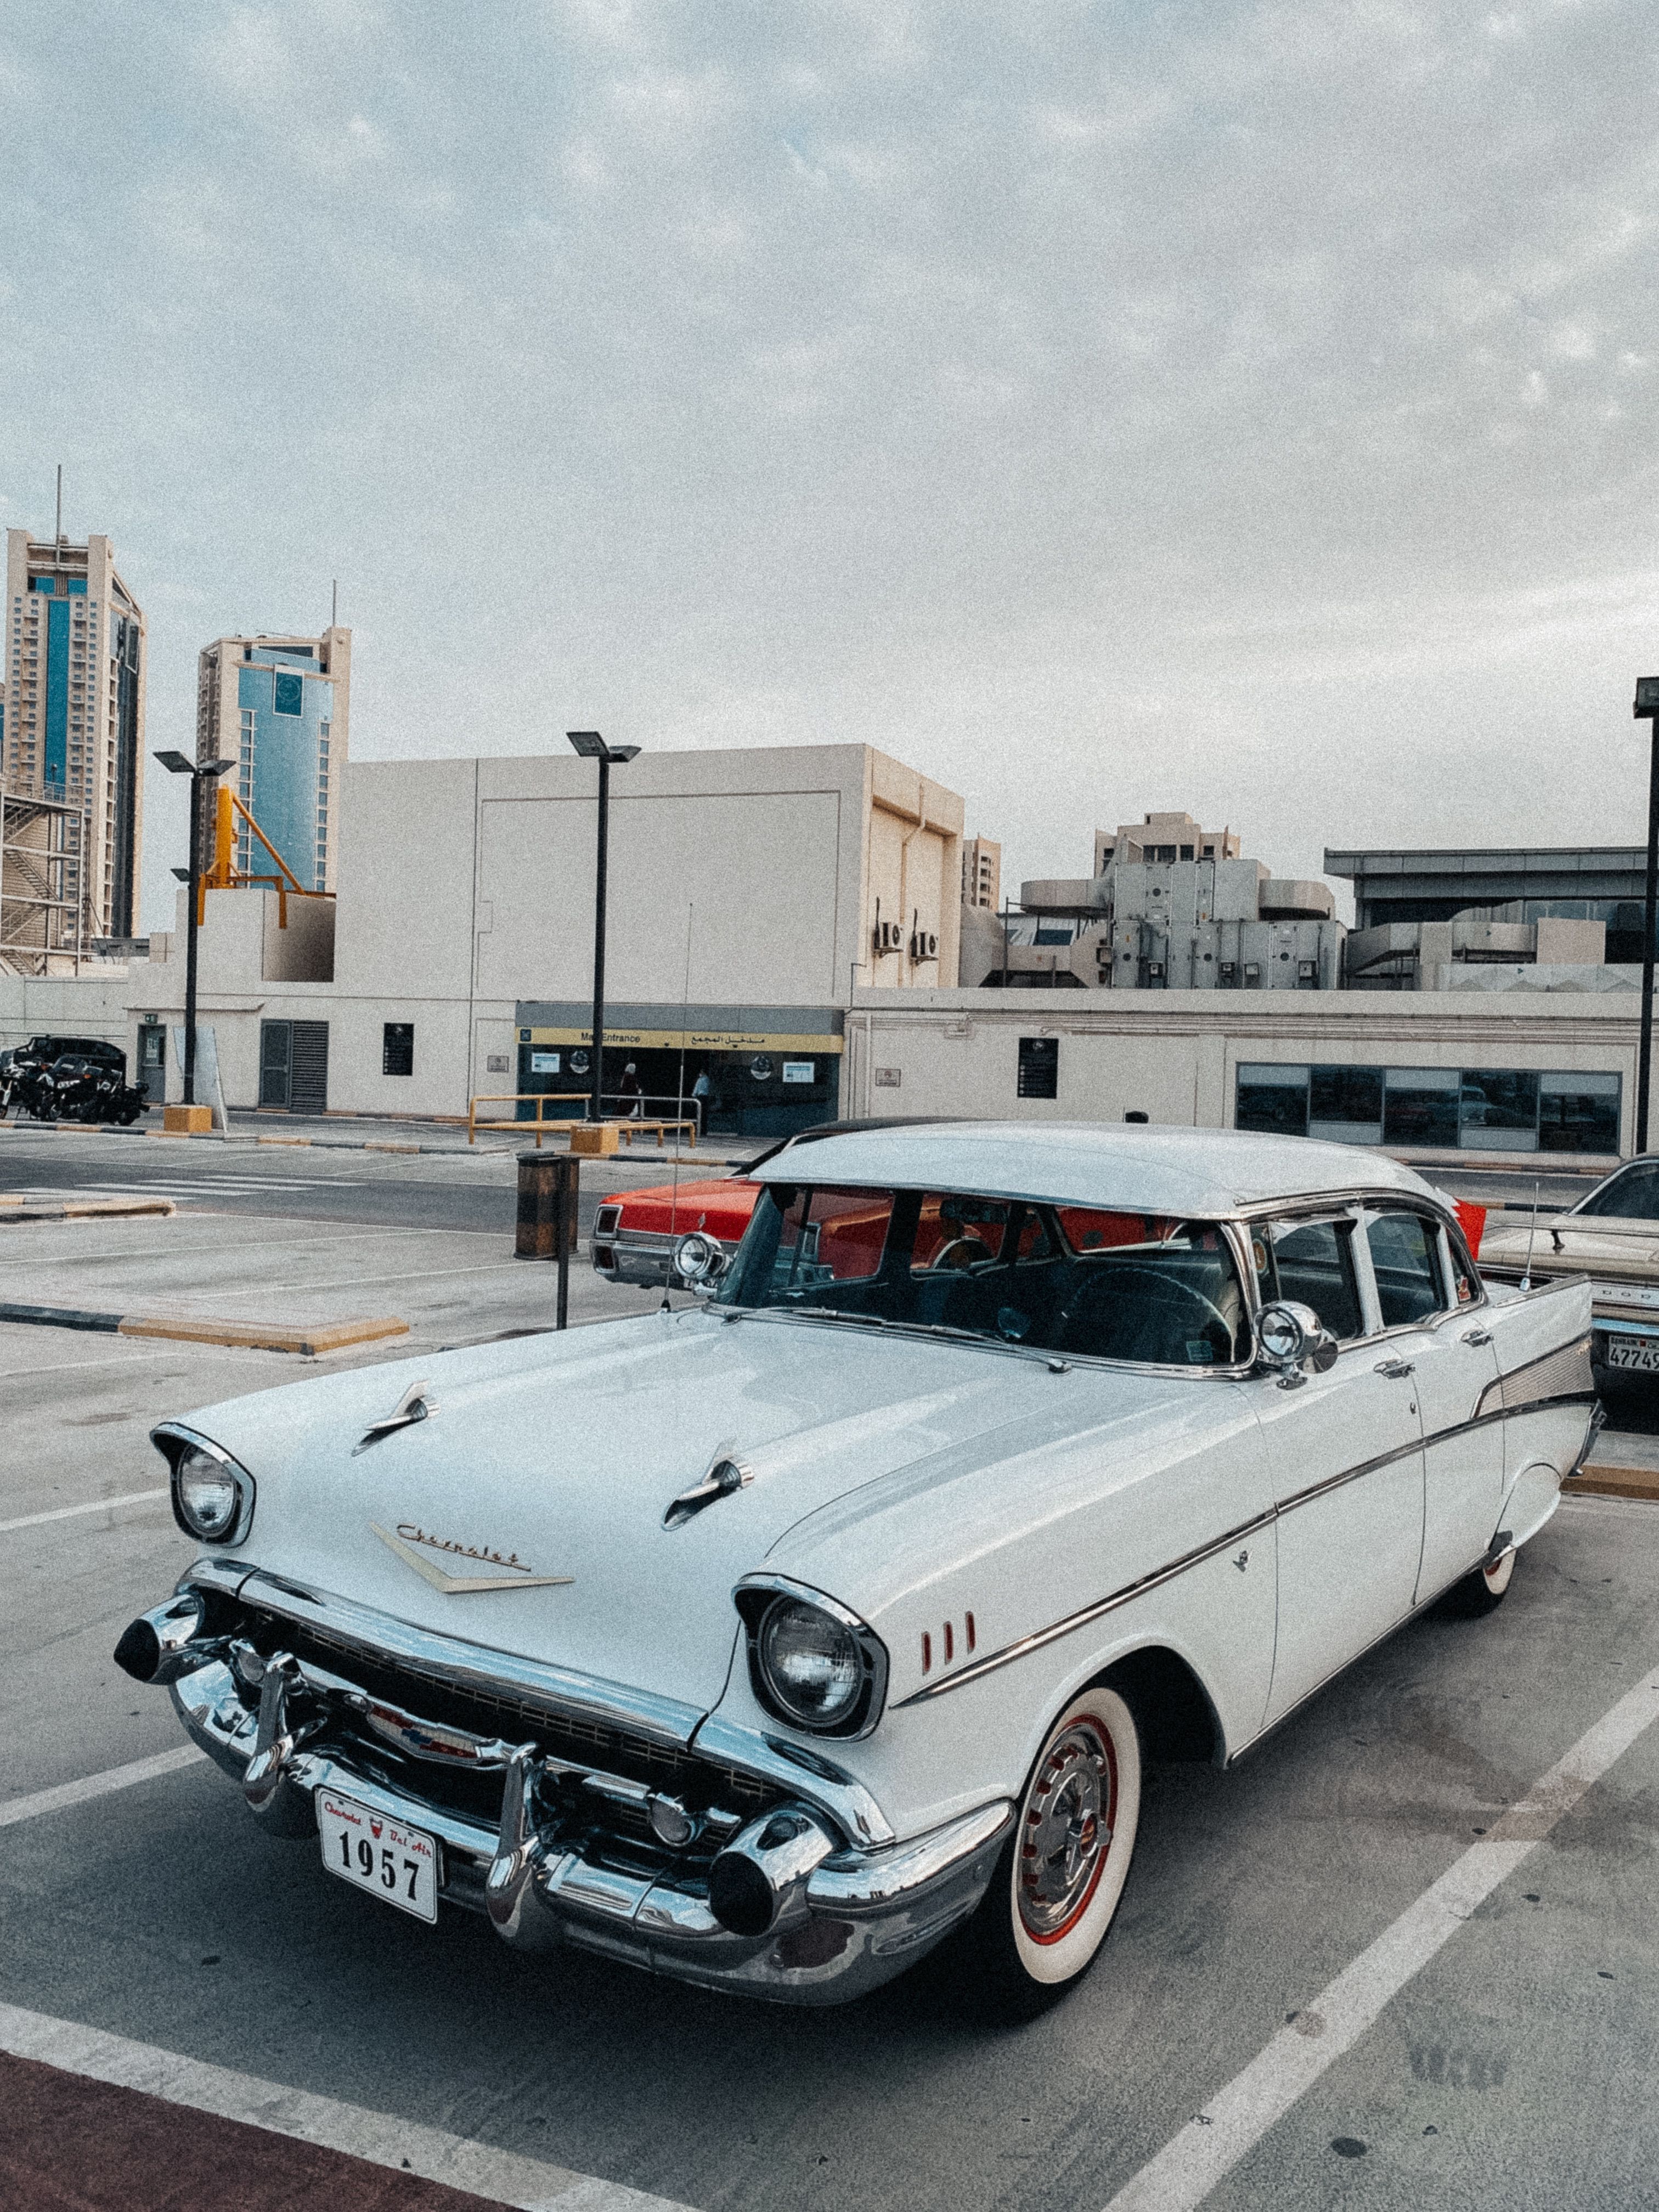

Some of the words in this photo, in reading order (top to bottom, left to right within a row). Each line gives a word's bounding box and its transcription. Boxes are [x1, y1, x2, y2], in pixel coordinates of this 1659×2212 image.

[602, 1032, 641, 1043] Entrance
[691, 1036, 723, 1045] المجمع
[397, 1525, 531, 1572] Chevrolet
[325, 1802, 362, 1826] Chevrolet
[390, 1829, 407, 1847] Bel
[412, 1842, 432, 1858] Air
[339, 1831, 420, 1901] 1957
